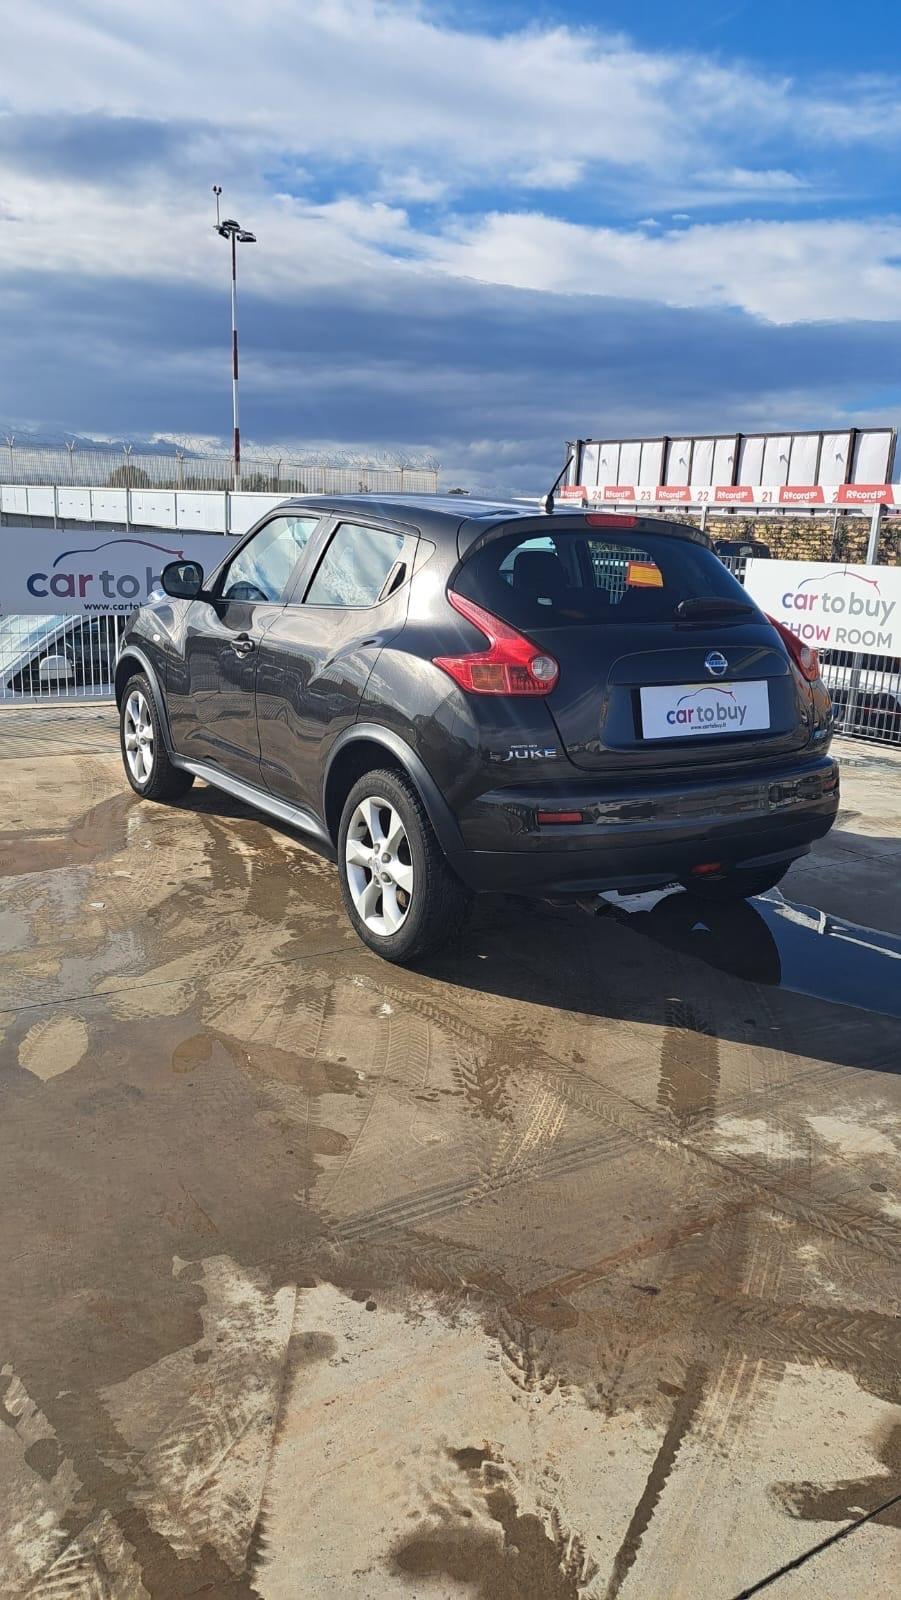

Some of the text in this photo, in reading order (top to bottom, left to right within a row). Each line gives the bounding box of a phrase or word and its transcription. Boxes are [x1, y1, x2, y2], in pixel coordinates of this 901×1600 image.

[641, 491, 651, 500] 23
[698, 491, 709, 501] 22
[762, 491, 772, 502] 21
[84, 602, 143, 611] www.carto
[780, 621, 893, 649] HOW ROOM
[502, 748, 557, 762] JUKE
